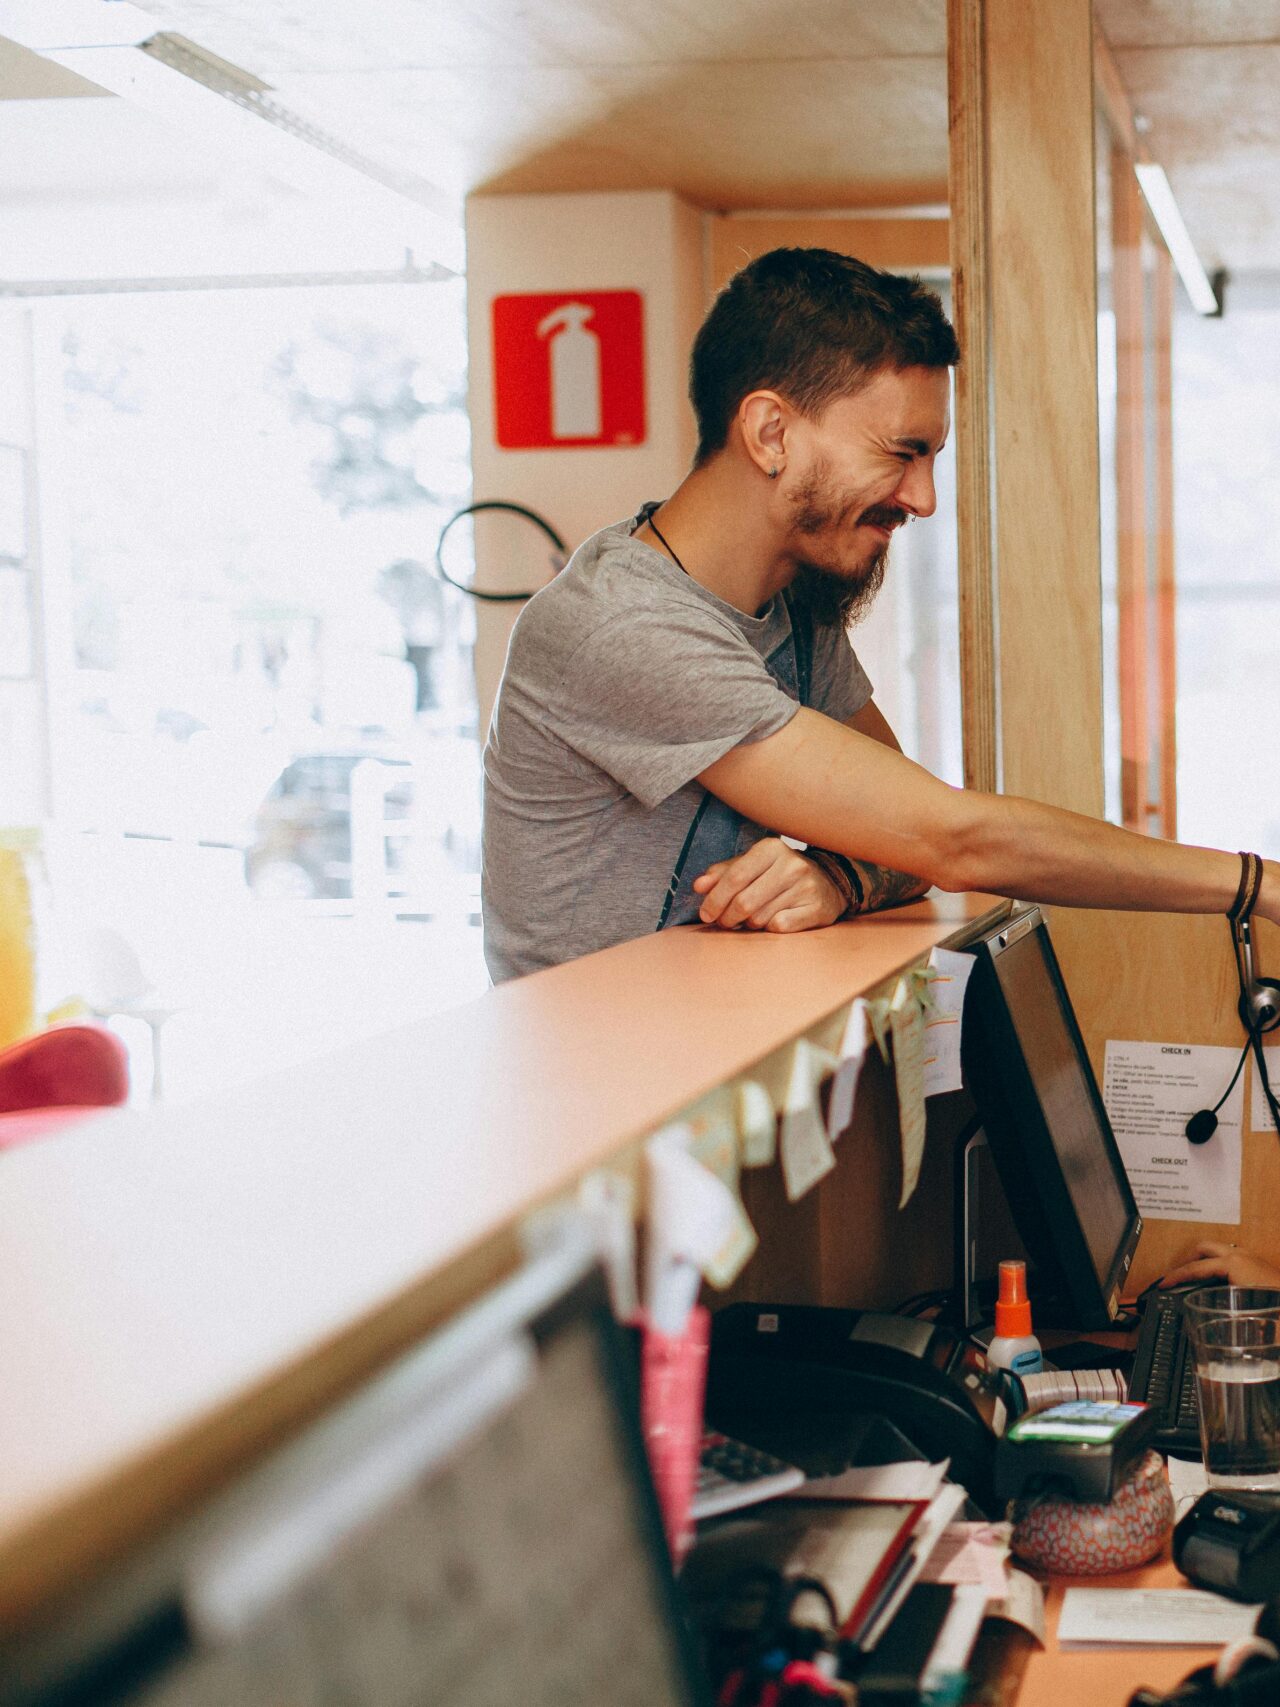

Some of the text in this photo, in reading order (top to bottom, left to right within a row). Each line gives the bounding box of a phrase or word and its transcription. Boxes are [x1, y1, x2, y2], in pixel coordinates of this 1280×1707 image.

[1161, 1046, 1192, 1056] CHECK IN
[1151, 1157, 1188, 1166] CHECK OUT
